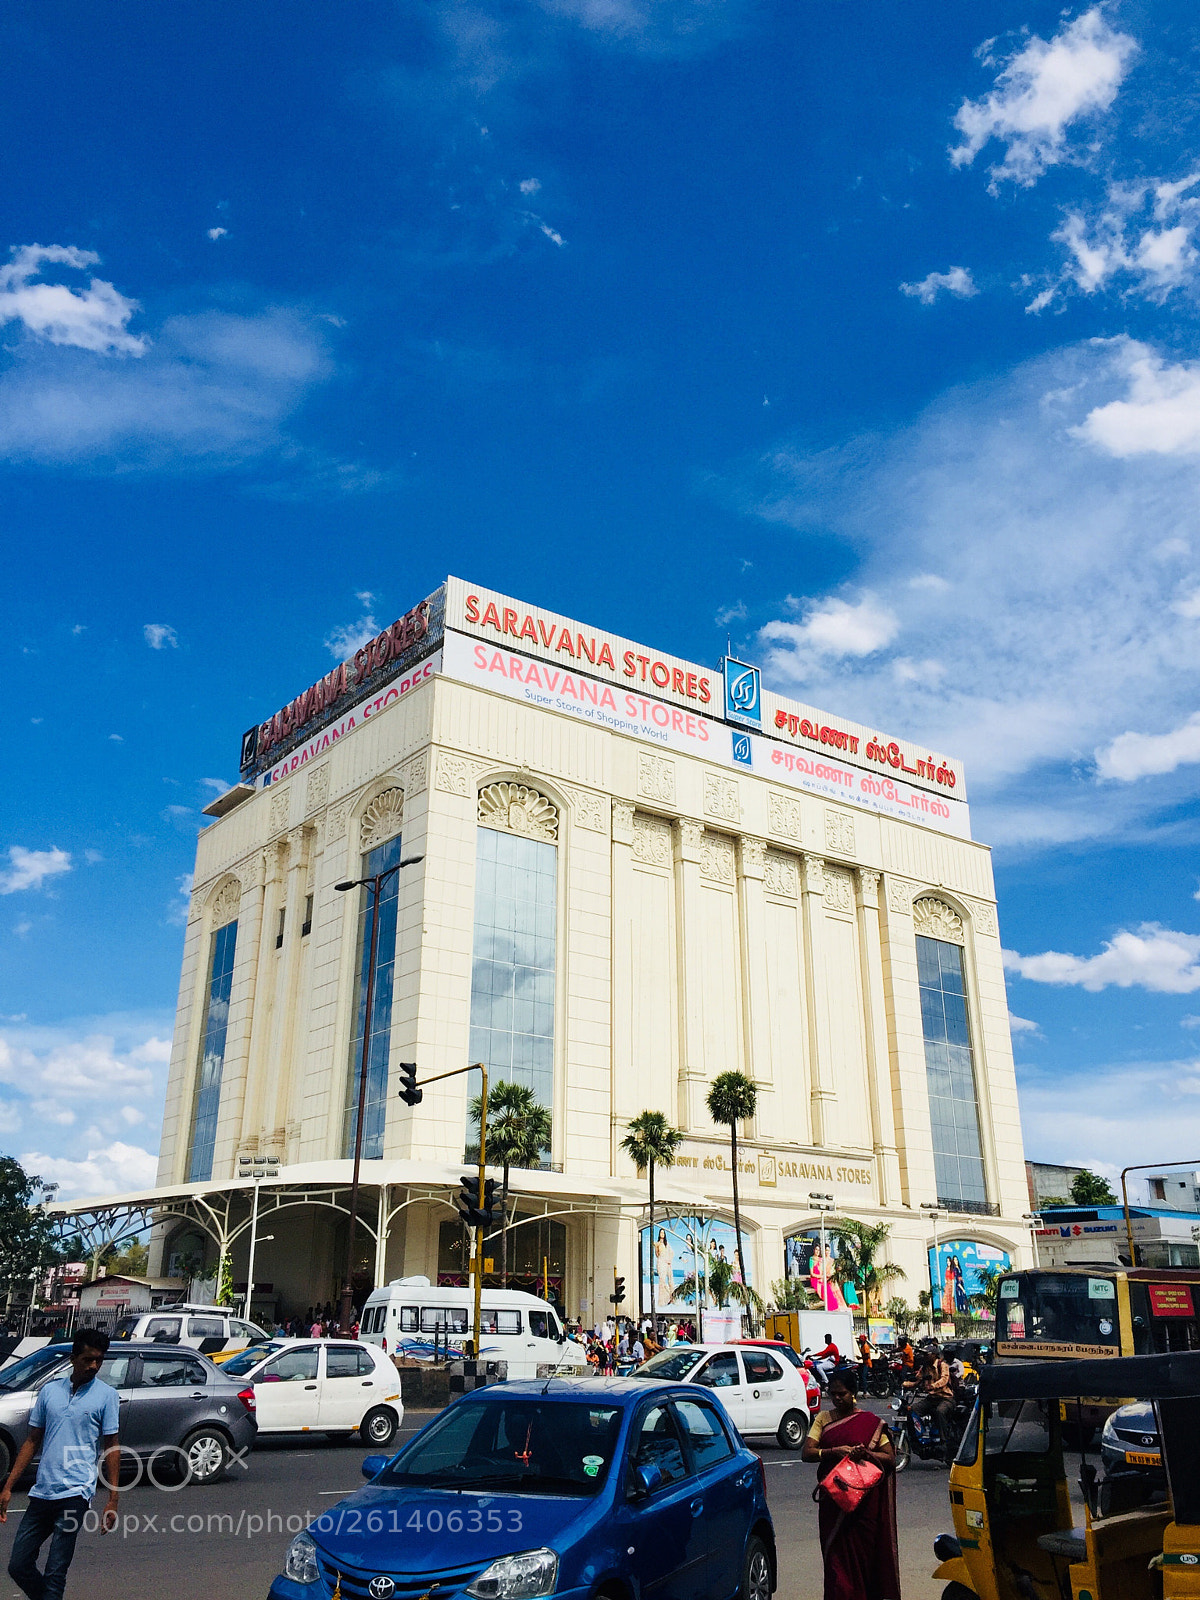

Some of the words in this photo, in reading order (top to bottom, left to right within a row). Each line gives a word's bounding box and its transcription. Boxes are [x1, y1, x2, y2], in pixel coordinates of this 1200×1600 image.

[465, 594, 616, 670] SARAVANA
[623, 650, 712, 703] STORES
[258, 660, 349, 755] SARAVANA
[352, 600, 429, 686] STORES
[474, 645, 617, 711] SARAVANA
[625, 695, 709, 742] STORES
[524, 688, 553, 705] Super
[556, 698, 583, 715] Store
[585, 708, 596, 718] of
[597, 712, 639, 734] Shopping
[640, 725, 668, 741] World
[728, 711, 745, 722] Super
[746, 717, 762, 729] Store
[775, 709, 859, 754] சரவணா
[866, 736, 956, 788] ஸ்டோர்ஸ்
[771, 749, 854, 788] சரவணா
[860, 774, 950, 819] ஸ்டோர்ஸ்
[703, 1154, 756, 1174] ஸ்டேர்ஸ்
[778, 1160, 833, 1181] SARAVANA
[836, 1166, 872, 1184] STORES
[1083, 1225, 1118, 1233] SUZUKI
[1004, 1284, 1016, 1292] MTC
[1094, 1284, 1109, 1292] MTC
